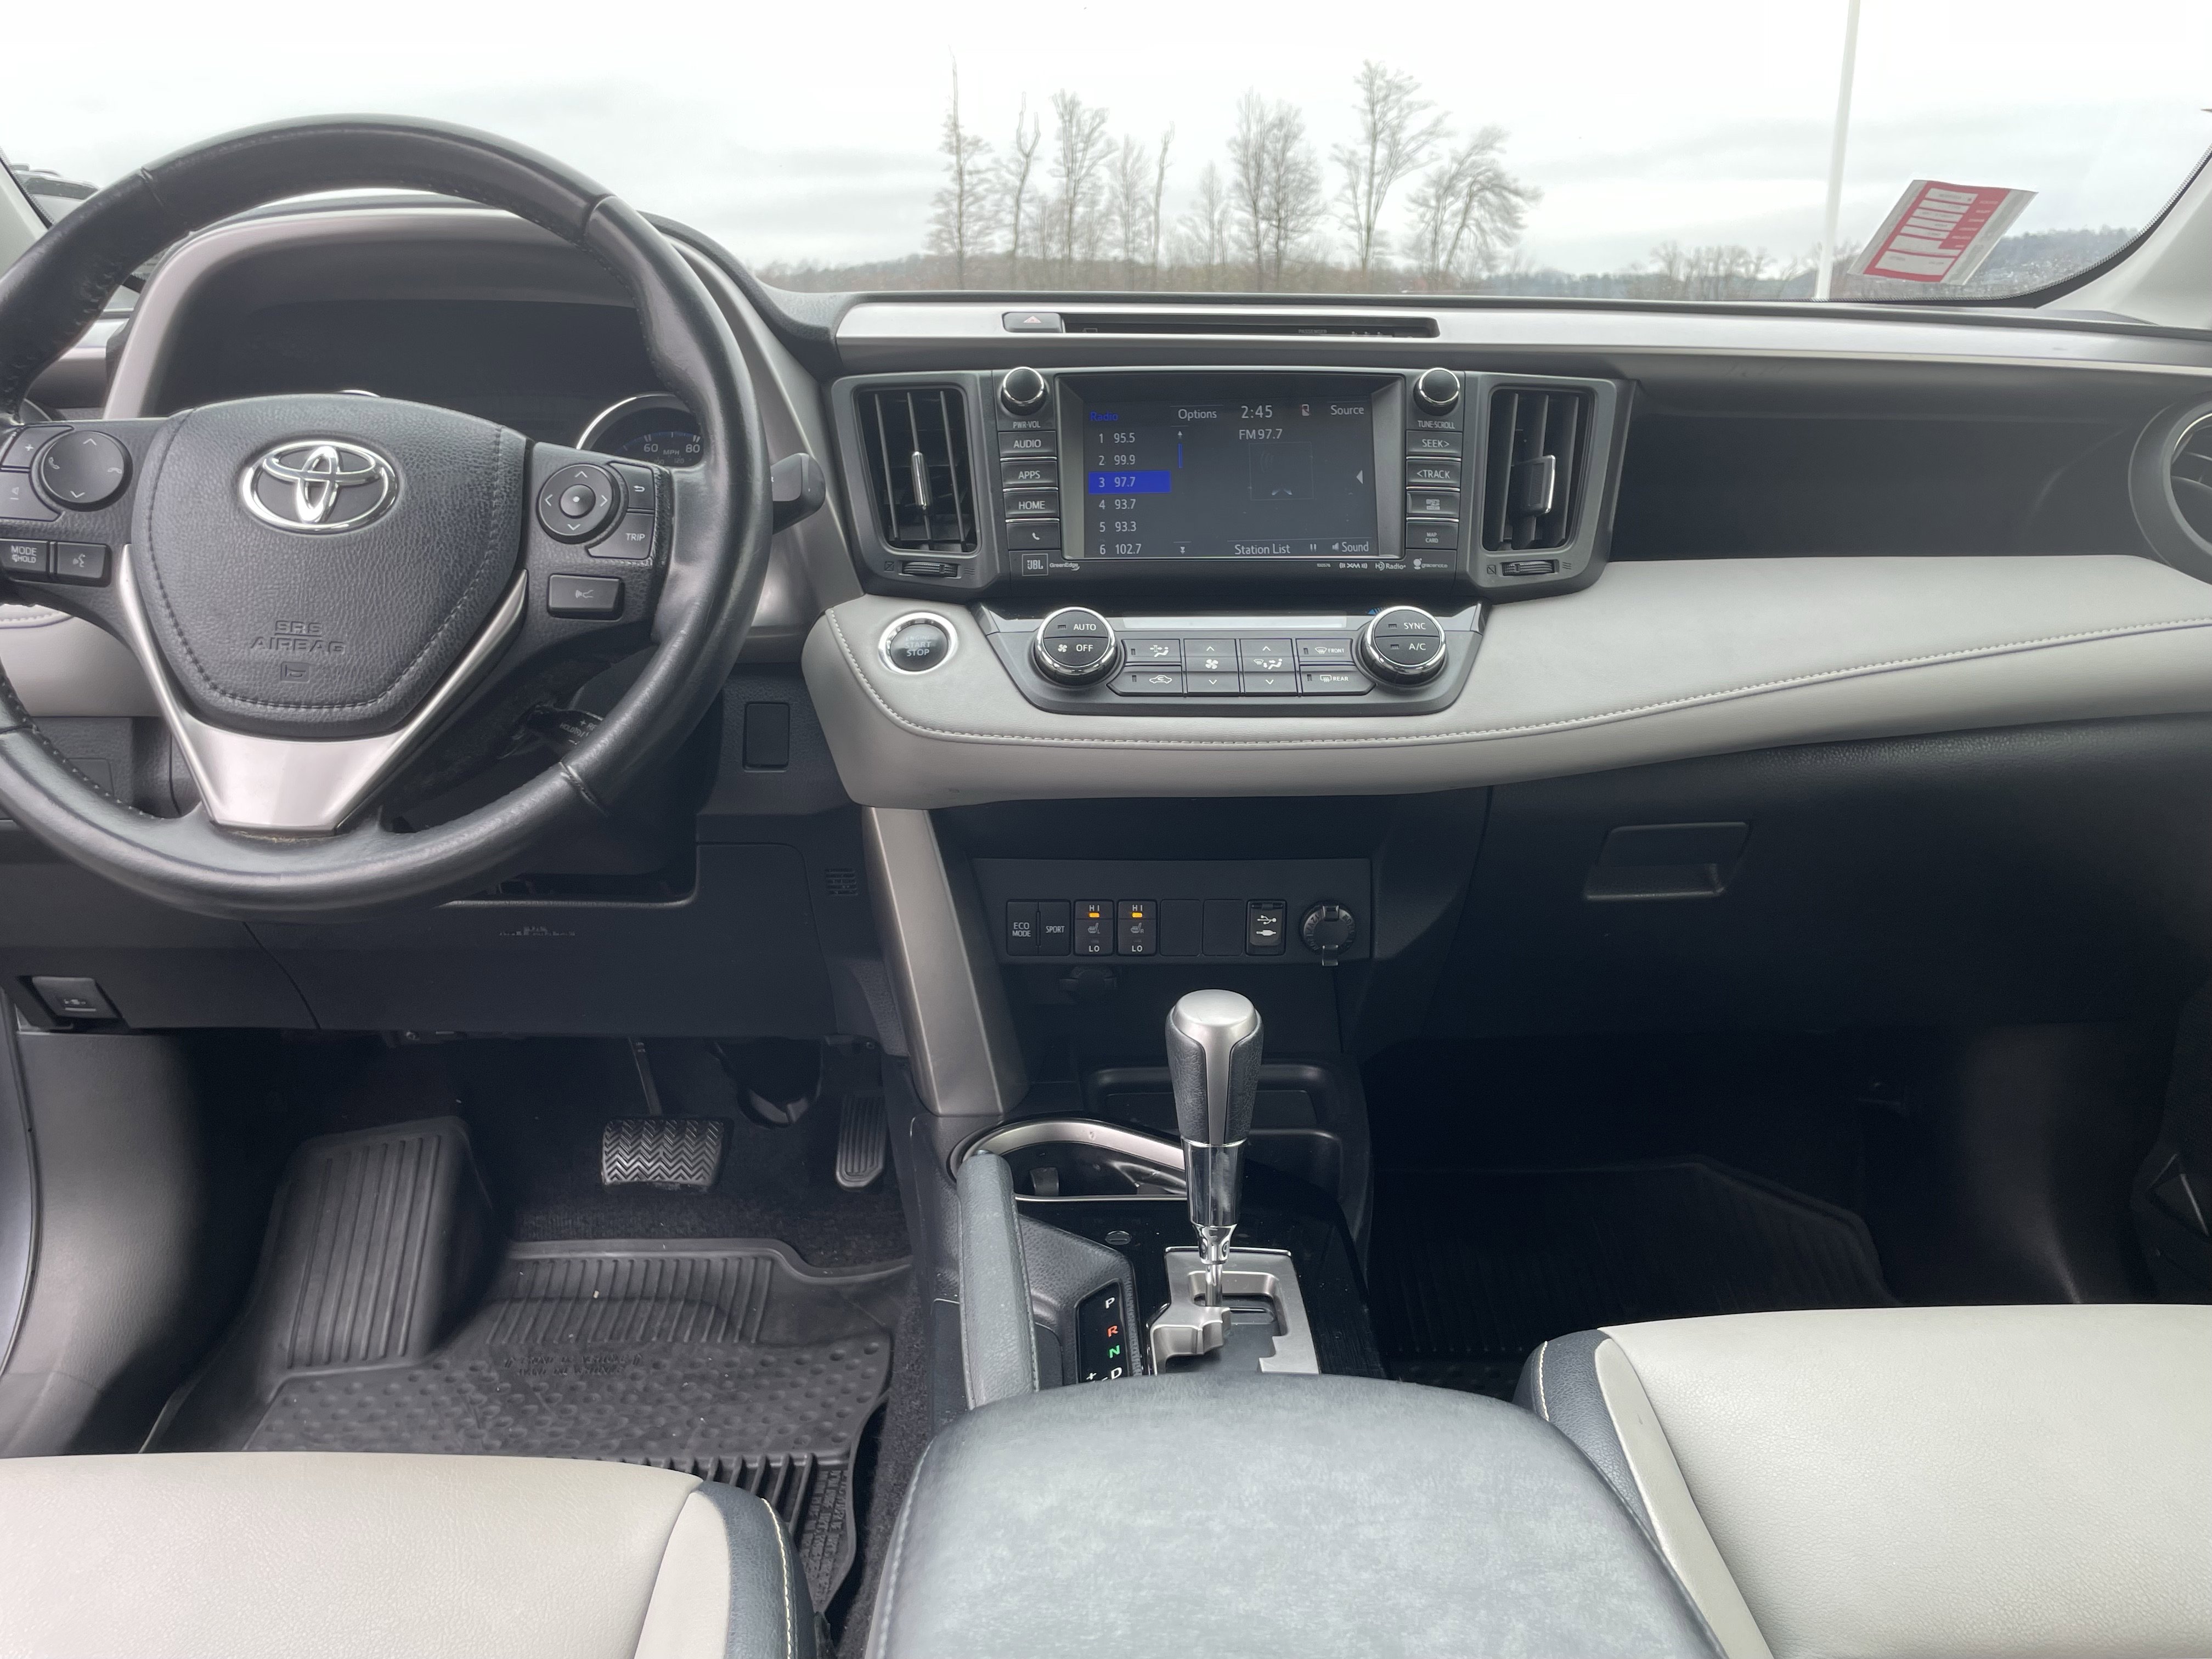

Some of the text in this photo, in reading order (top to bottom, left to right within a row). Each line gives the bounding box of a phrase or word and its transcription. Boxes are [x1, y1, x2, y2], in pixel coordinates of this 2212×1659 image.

[1178, 409, 1217, 421] Options
[1241, 405, 1273, 419] 2:45
[1330, 405, 1364, 415] Source
[1090, 411, 1119, 421] Radio
[1099, 432, 1135, 443] 1 95.5
[644, 443, 658, 453] 60
[686, 444, 701, 453] 80
[1013, 439, 1041, 448] AUDIO
[1099, 455, 1136, 466] 2 99.9
[1018, 471, 1040, 479] APPS
[1099, 477, 1136, 488] 3 97.7
[1019, 501, 1045, 510] HOME
[1099, 499, 1136, 510] 4 93.7
[1099, 521, 1137, 532] 5 93.3
[626, 533, 645, 541] TRIP
[11, 545, 37, 556] MODE
[1099, 544, 1142, 555] 6 102.7
[1234, 543, 1291, 555] Station List
[1341, 541, 1369, 552] Sound
[1027, 560, 1043, 569] JBL
[906, 648, 930, 657] STOP
[1105, 1297, 1115, 1309] P
[1107, 1325, 1119, 1338] R
[1109, 1345, 1120, 1358] N
[1111, 1367, 1122, 1380] D
